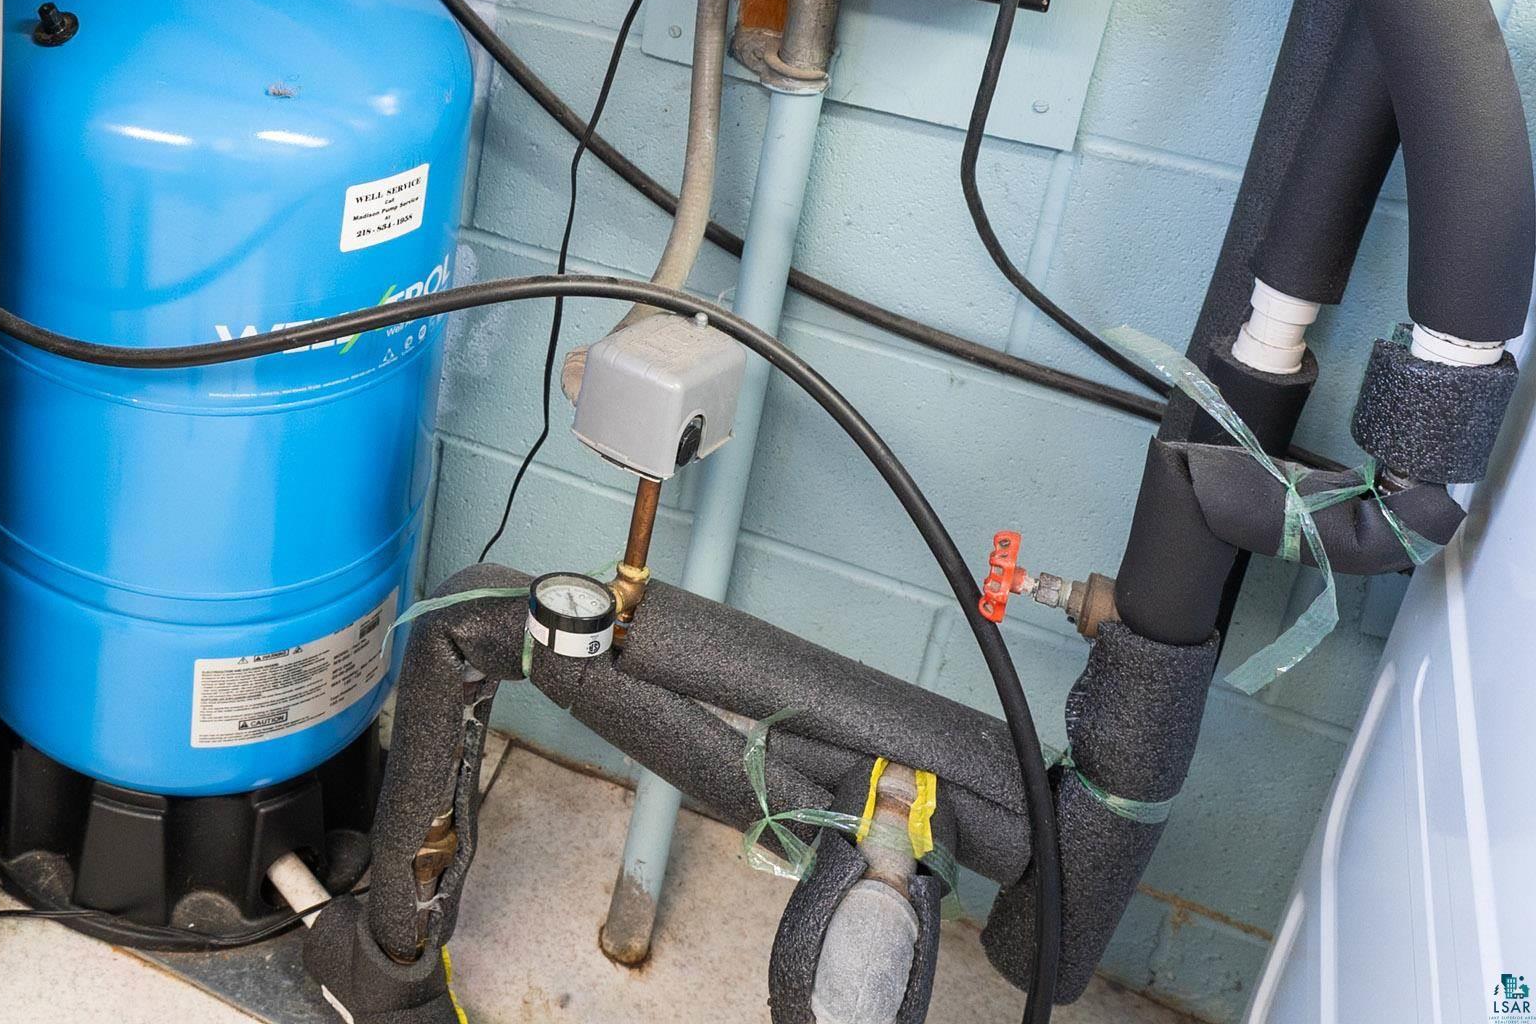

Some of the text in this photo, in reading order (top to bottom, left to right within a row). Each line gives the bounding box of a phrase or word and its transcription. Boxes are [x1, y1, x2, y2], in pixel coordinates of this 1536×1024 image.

[355, 177, 421, 204] WELL SERVICE
[353, 197, 419, 221] Madison Pump Service
[250, 715, 284, 727] CAUTION
